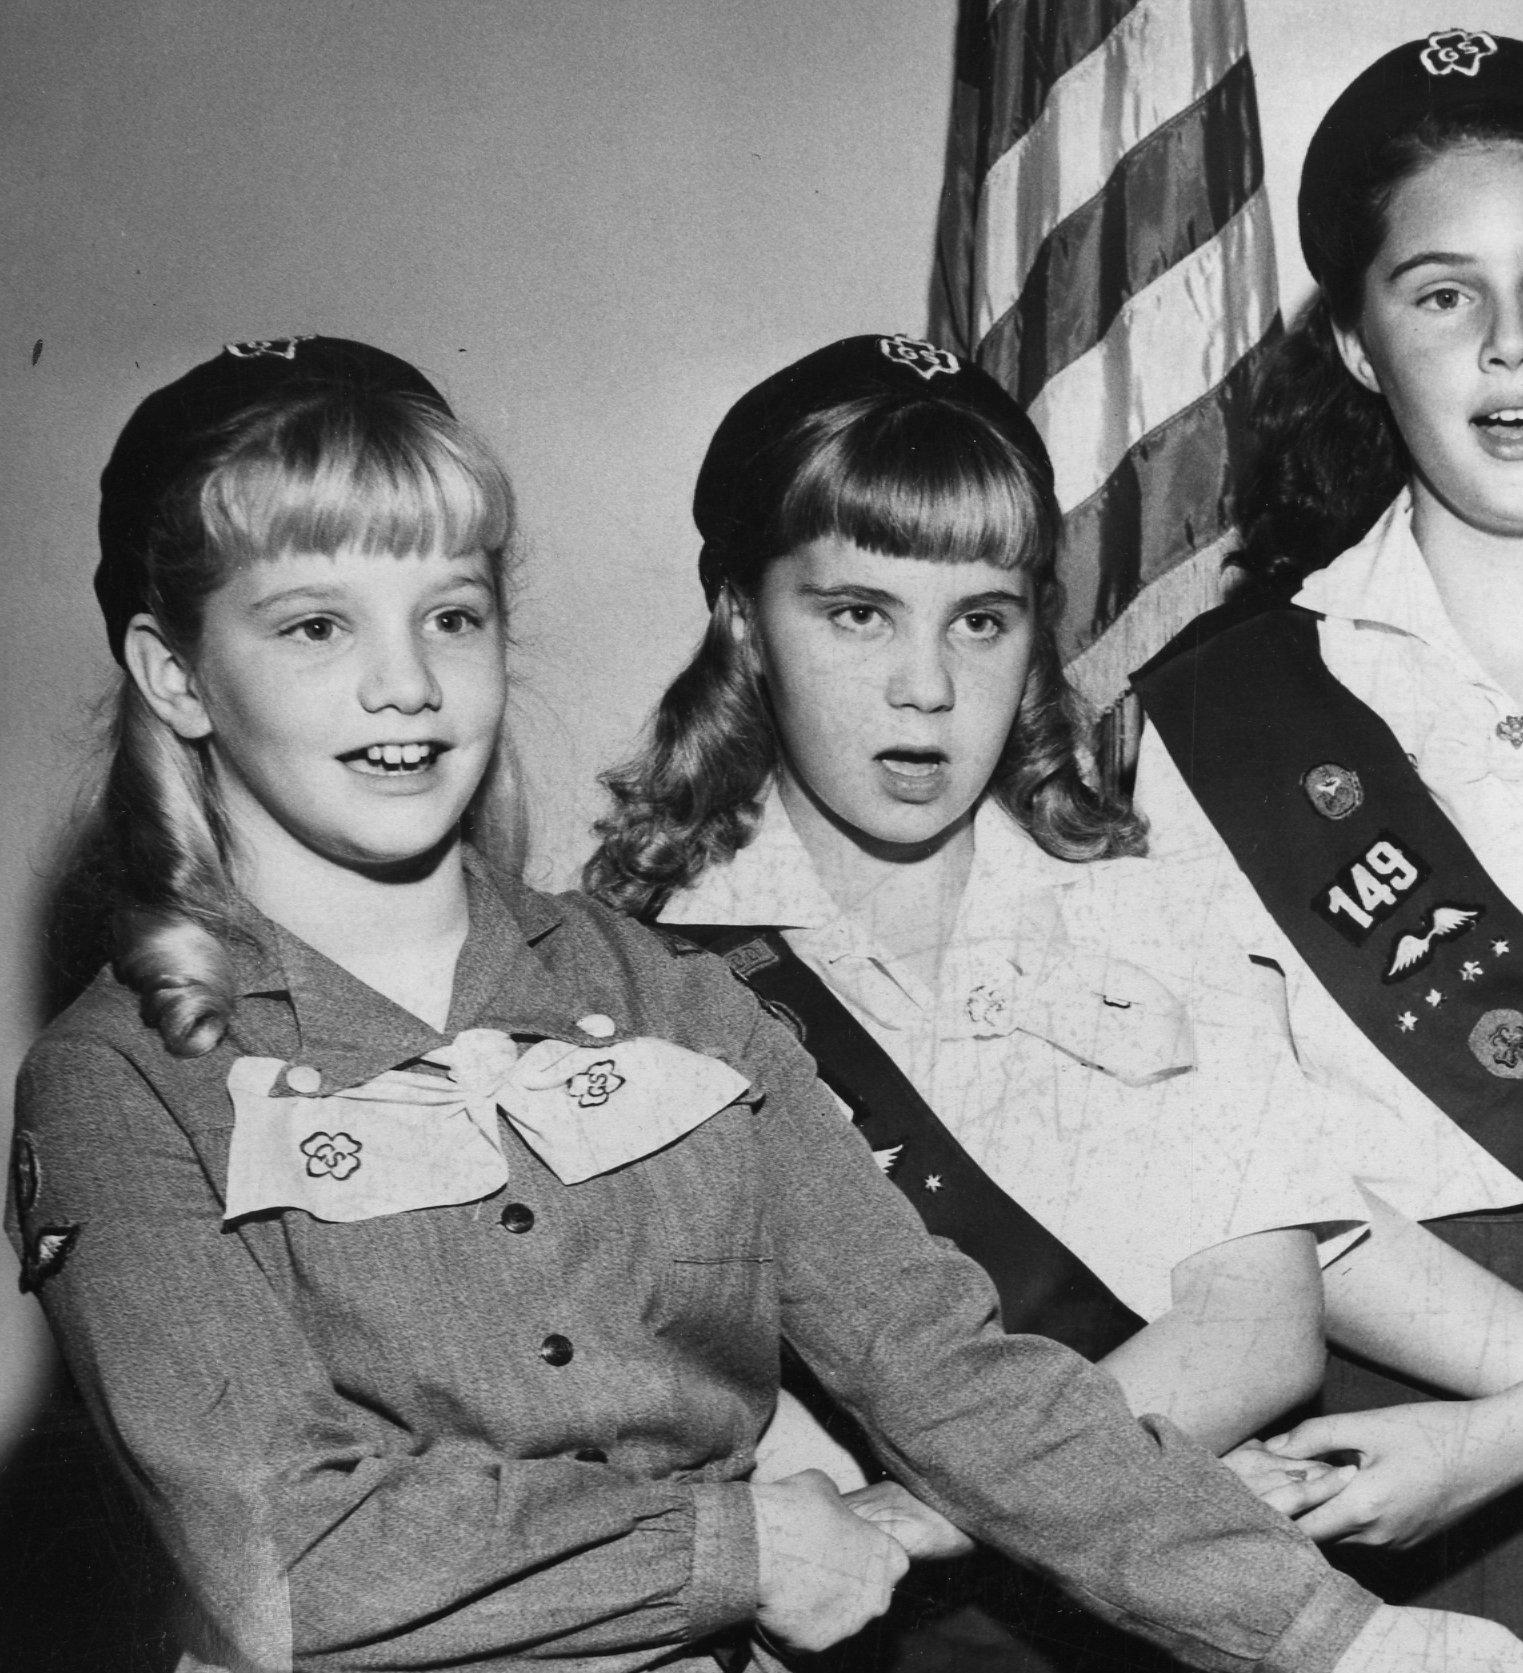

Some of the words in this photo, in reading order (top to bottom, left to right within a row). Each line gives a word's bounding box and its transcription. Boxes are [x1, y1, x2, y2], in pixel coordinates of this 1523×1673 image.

[1439, 41, 1479, 62] GS
[898, 346, 940, 365] GS
[1328, 841, 1418, 928] 149
[587, 1072, 608, 1097] GS
[314, 1143, 346, 1168] GS
